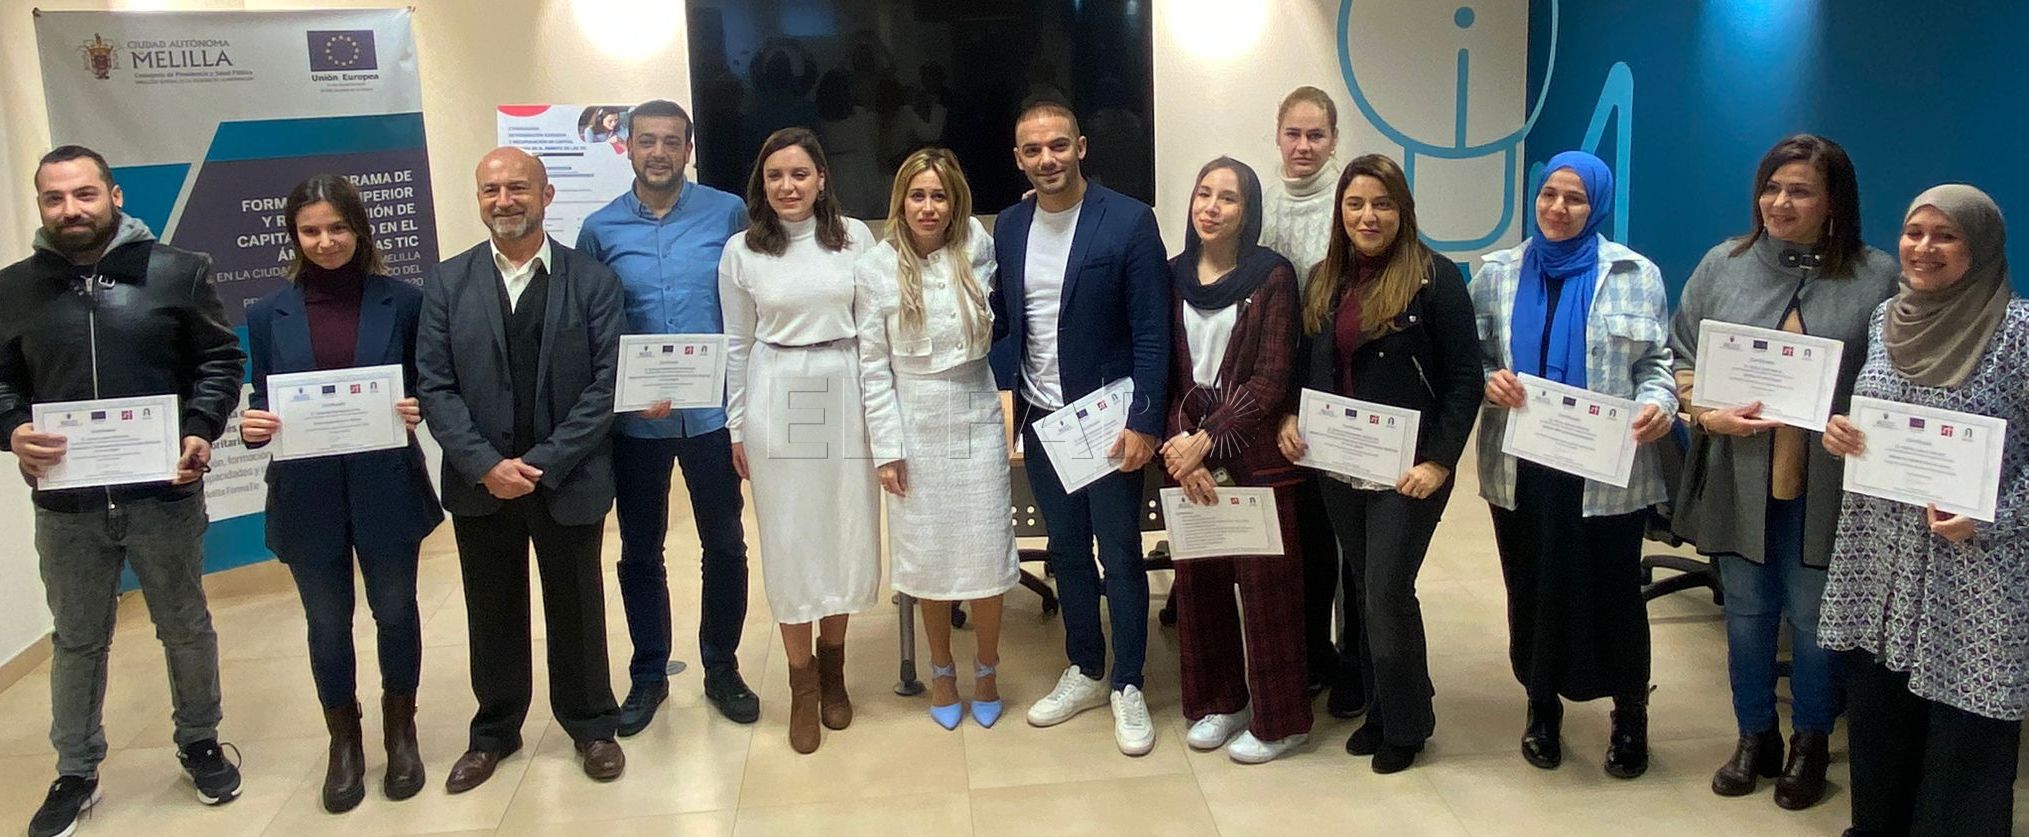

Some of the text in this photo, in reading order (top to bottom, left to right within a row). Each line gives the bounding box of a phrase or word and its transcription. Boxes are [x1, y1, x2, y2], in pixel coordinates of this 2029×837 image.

[127, 40, 166, 49] CIUDAD
[130, 50, 234, 69] MELILLA
[311, 73, 379, 82] Unión Europea
[341, 170, 413, 187] RAMA DE
[241, 187, 414, 213] FORM PERIOR
[262, 215, 272, 228] Y
[397, 203, 416, 216] DE
[236, 232, 293, 249] CAPITA
[379, 221, 398, 234] EN
[401, 219, 418, 232] EL
[395, 235, 419, 248] TIC
[216, 271, 233, 283] EN
[235, 269, 251, 281] LA
[403, 264, 422, 276] DEL
